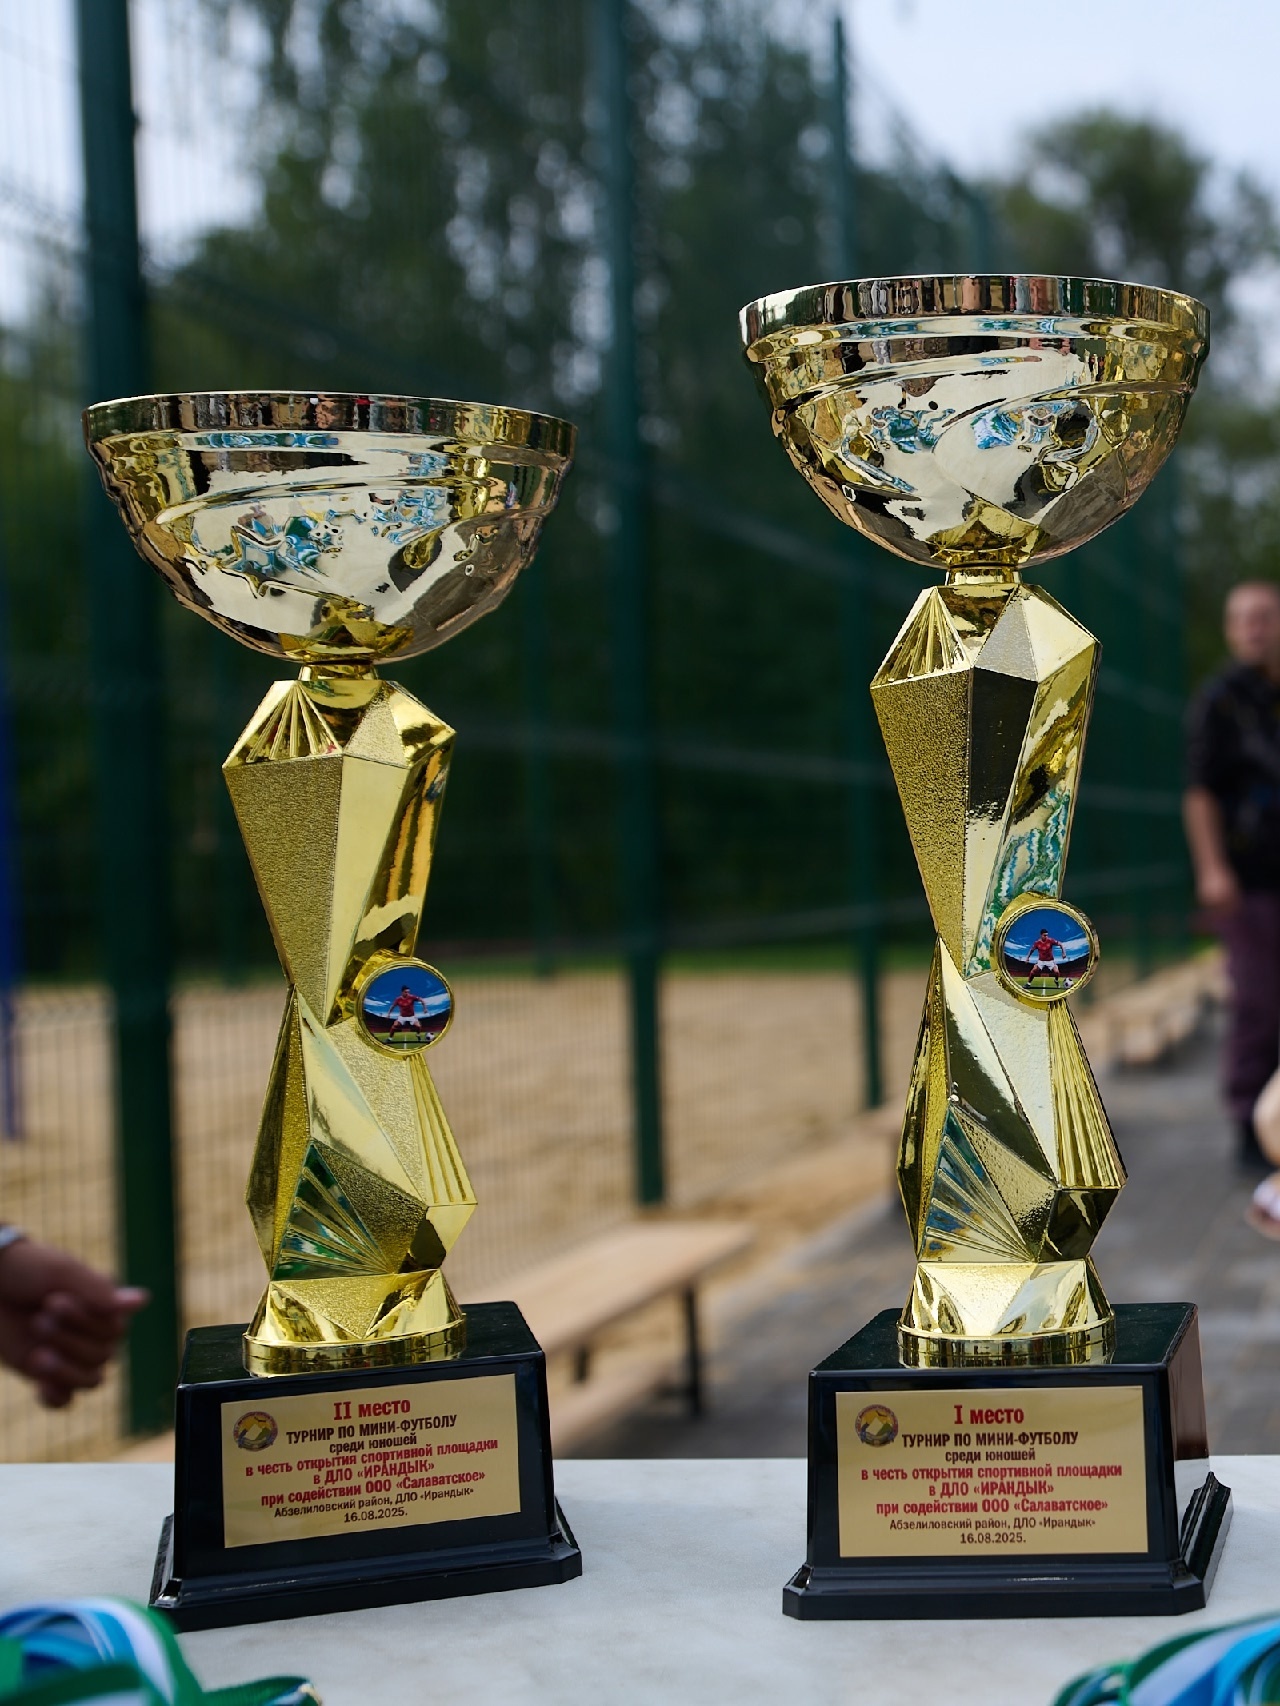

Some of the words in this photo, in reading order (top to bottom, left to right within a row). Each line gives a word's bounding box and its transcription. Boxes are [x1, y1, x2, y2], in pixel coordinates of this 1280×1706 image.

[334, 1402, 351, 1420] II
[358, 1400, 411, 1418] место
[954, 1405, 963, 1424] I
[970, 1407, 1024, 1424] место
[286, 1430, 334, 1444] ТУРНИР
[338, 1426, 355, 1438] ПО
[359, 1415, 457, 1437] МИНИ-ФУТБОЛУ
[329, 1441, 364, 1456] среди
[369, 1434, 417, 1449] юношей
[902, 1434, 950, 1447] ТУРНИР
[954, 1434, 971, 1446] ПО
[975, 1432, 1078, 1446] МИНИ-ФУТБОЛУ
[246, 1466, 253, 1476] в
[258, 1463, 292, 1474] честь
[297, 1454, 357, 1474] открытия
[361, 1444, 433, 1464] спортивной
[437, 1439, 498, 1456] площадки
[946, 1451, 981, 1463] среди
[986, 1449, 1035, 1461] юношей
[314, 1475, 320, 1484] в
[325, 1468, 352, 1485] ДЛО
[358, 1461, 434, 1481] «ИРАНДЫК»
[861, 1471, 868, 1480] в
[873, 1469, 907, 1480] честь
[913, 1468, 973, 1481] открытия
[978, 1464, 1052, 1480] спортивной
[1057, 1465, 1122, 1478] площадки
[262, 1494, 283, 1507] при
[288, 1485, 361, 1504] содействии
[366, 1480, 391, 1494] ООО
[397, 1471, 485, 1490] «Салаватское»
[929, 1487, 935, 1496] в
[940, 1483, 968, 1498] ДЛО
[974, 1481, 1054, 1497] «ИРАНДЫК»
[275, 1499, 355, 1518] Абзелиловский
[358, 1496, 393, 1510] район,
[395, 1493, 418, 1504] ДЛО
[420, 1487, 474, 1501] «Ирандык»
[877, 1504, 899, 1516] при
[904, 1499, 977, 1515] содействии
[982, 1499, 1009, 1512] ООО
[1014, 1499, 1108, 1512] «Салаватское»
[344, 1510, 407, 1523] 16.08.2025.
[890, 1519, 972, 1530] Абзелиловский
[975, 1519, 1010, 1531] район,
[1013, 1518, 1036, 1529] ДЛО
[1039, 1517, 1095, 1529] «Ирандык»
[960, 1533, 1026, 1544] 16.08.2025.
